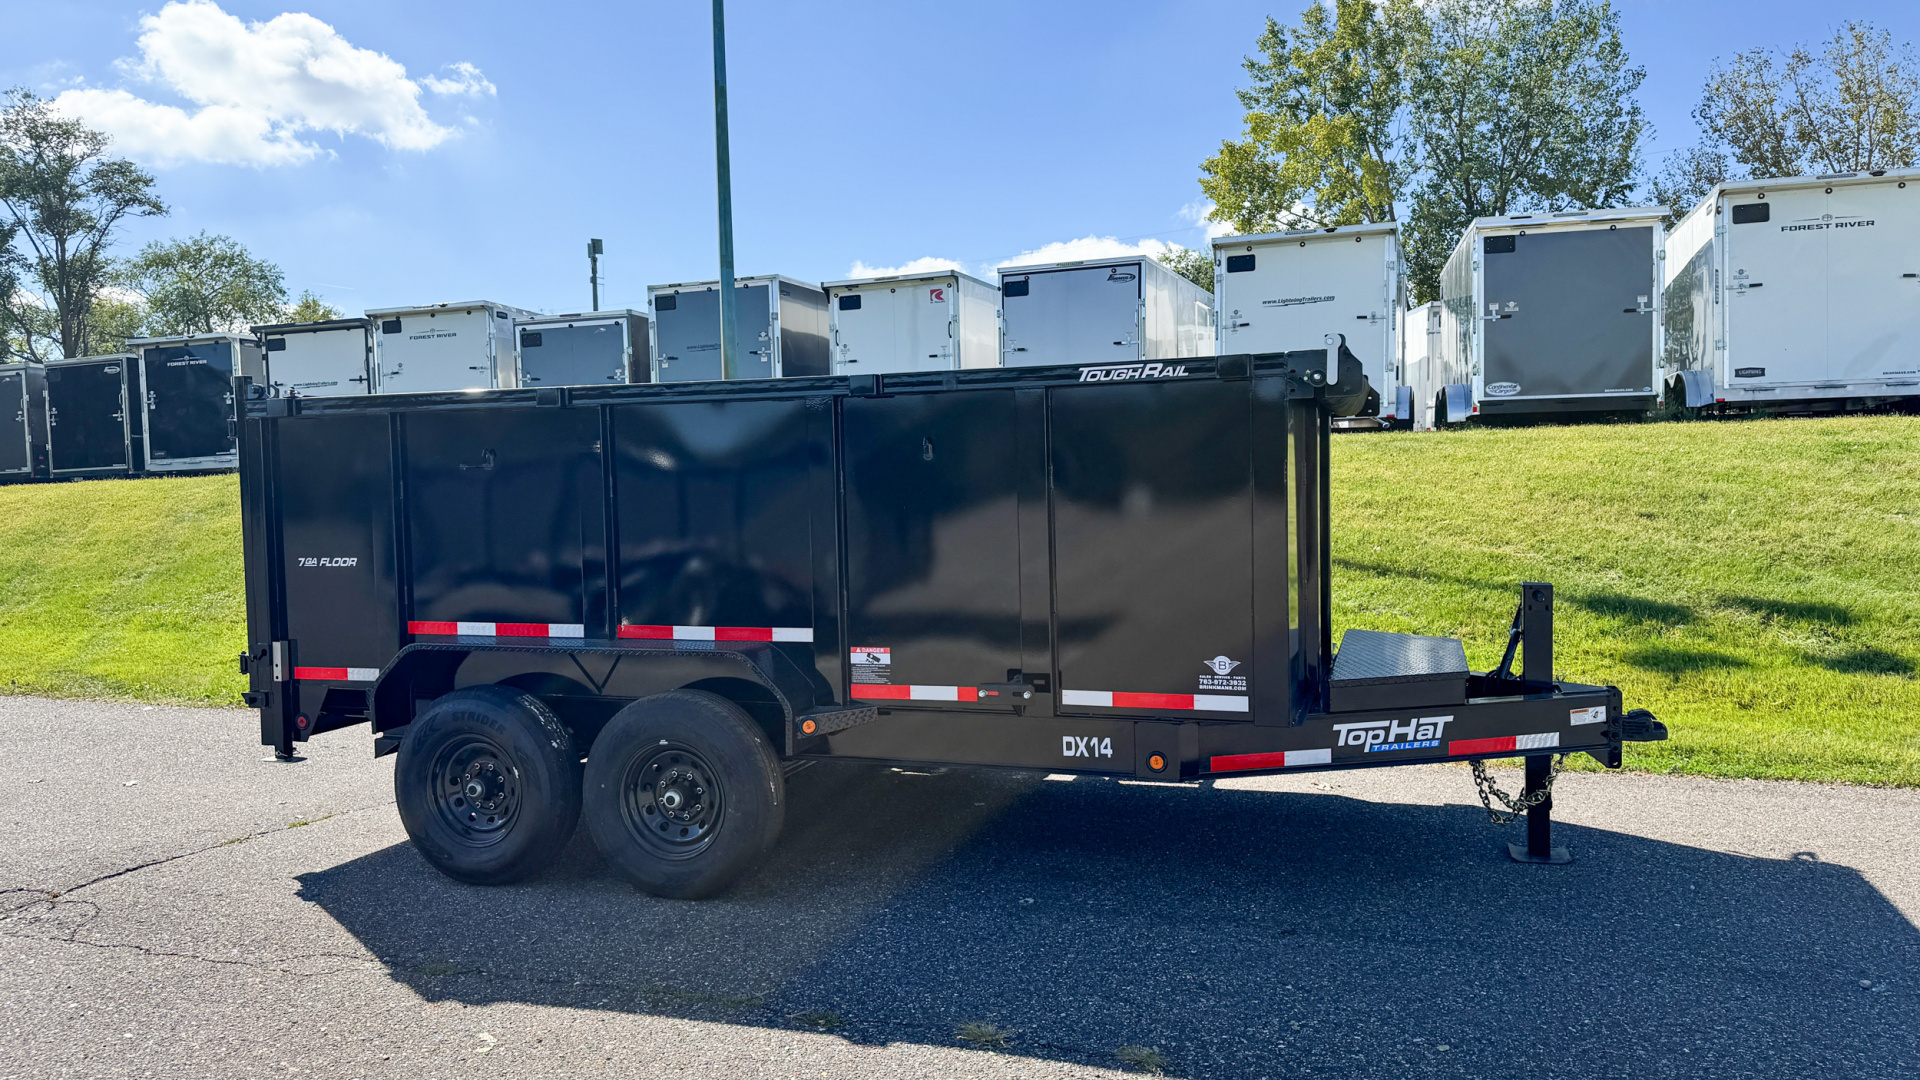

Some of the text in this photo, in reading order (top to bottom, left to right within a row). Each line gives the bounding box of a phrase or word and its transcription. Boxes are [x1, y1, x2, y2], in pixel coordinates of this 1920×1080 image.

[1781, 220, 1875, 232] FOREST RIVER
[319, 557, 358, 567] FLOOR
[1218, 660, 1227, 670] B
[1198, 678, 1247, 686] 763-972-3932
[1062, 735, 1113, 758] DX14
[1373, 739, 1440, 752] TRAILERS
